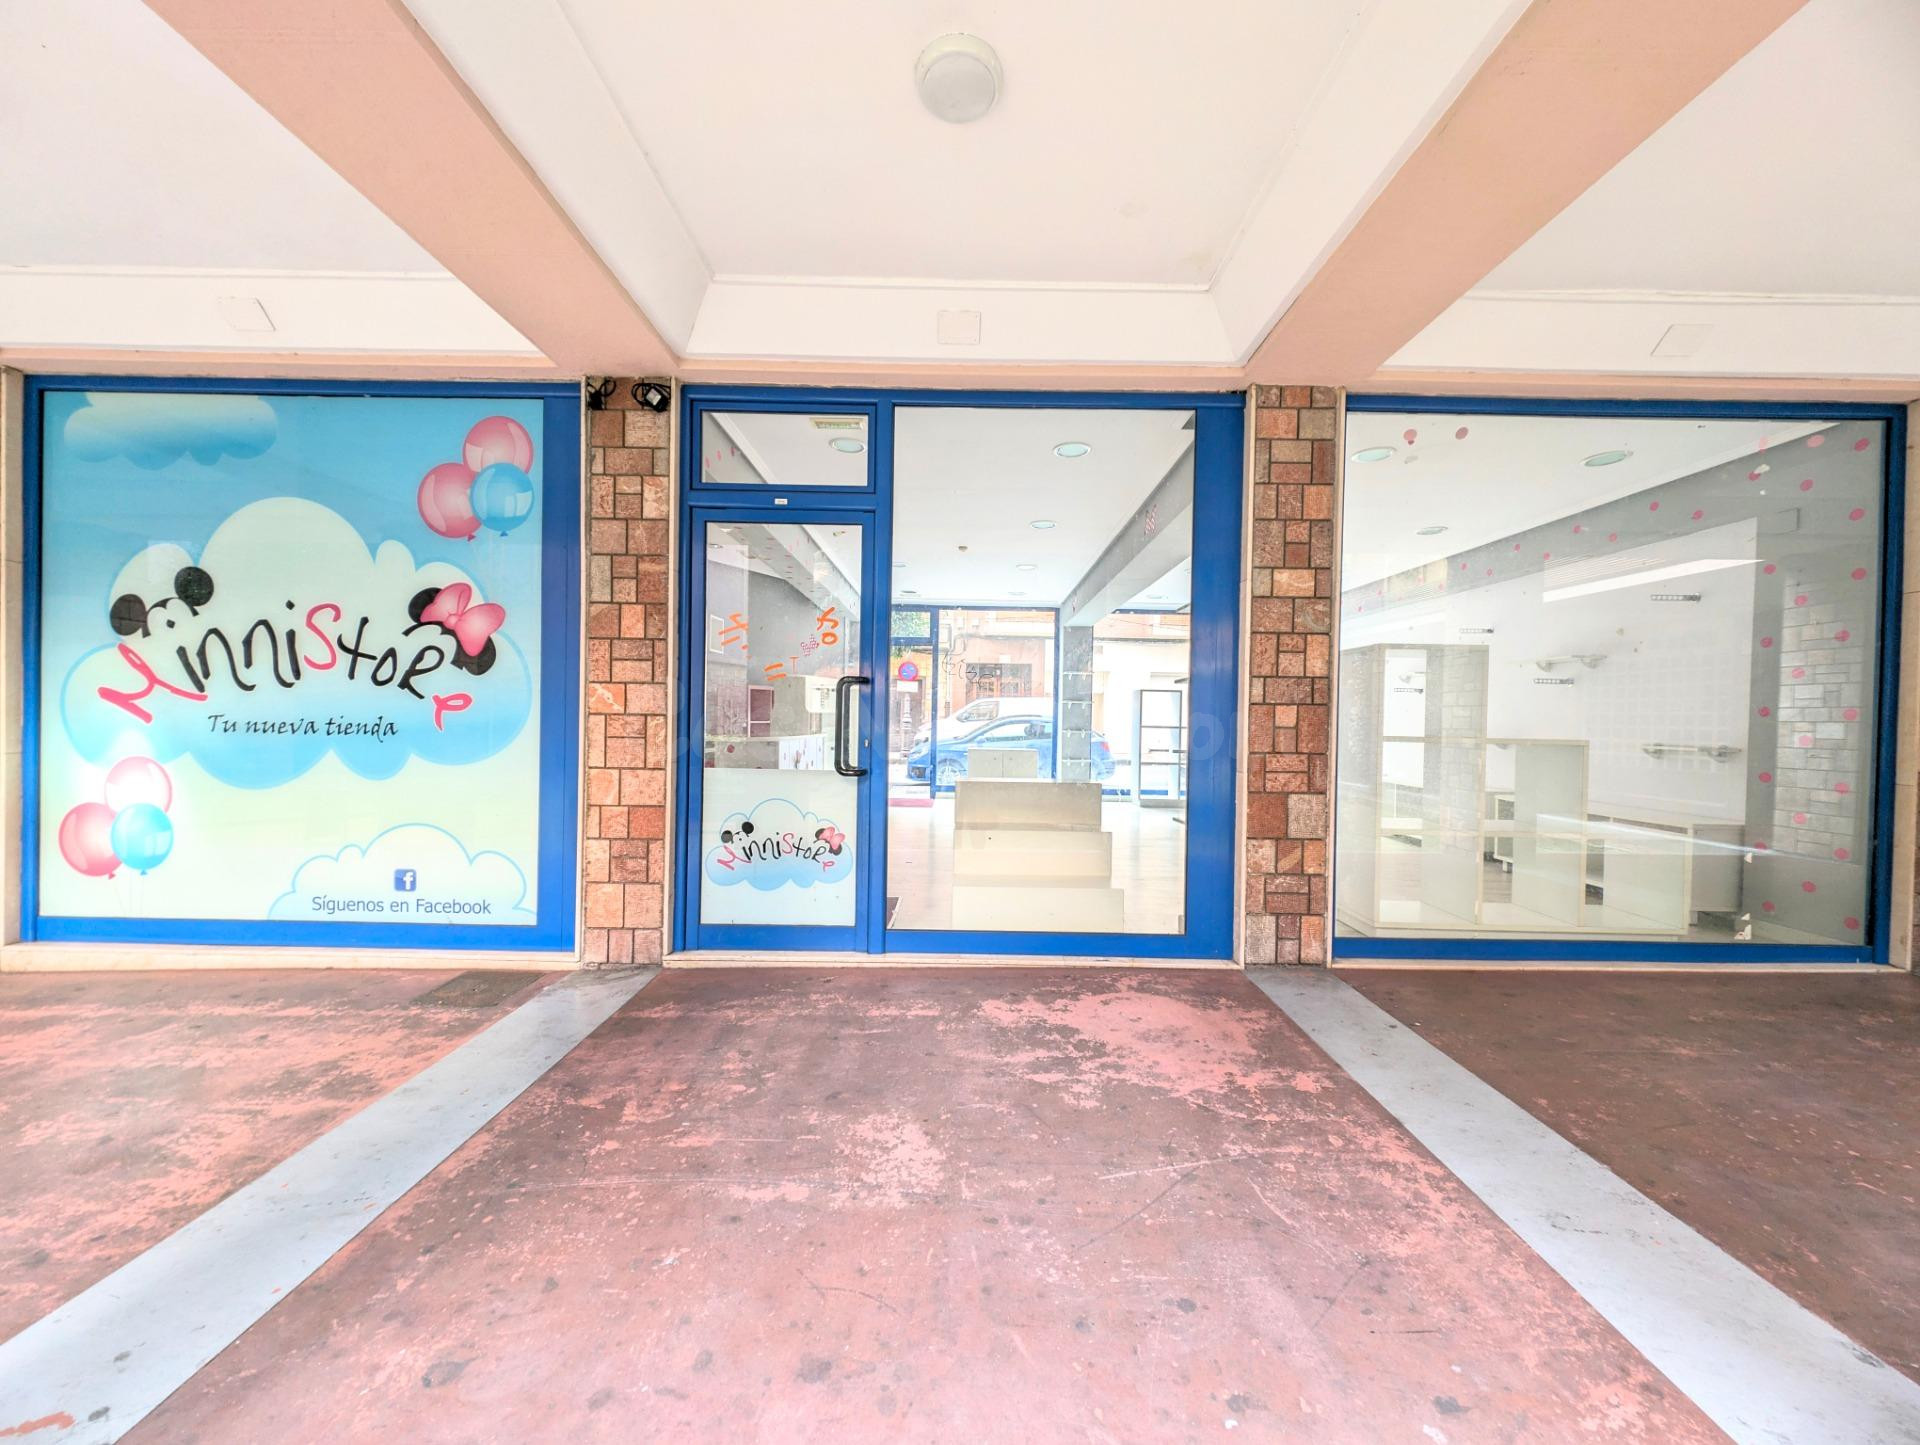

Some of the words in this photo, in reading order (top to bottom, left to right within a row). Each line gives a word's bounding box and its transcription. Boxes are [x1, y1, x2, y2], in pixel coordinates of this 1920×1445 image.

[208, 714, 237, 734] Tu
[245, 718, 320, 736] nueva
[324, 715, 399, 744] tienda
[312, 895, 384, 915] Síguenos
[389, 900, 409, 913] en
[416, 898, 492, 914] Facebook
